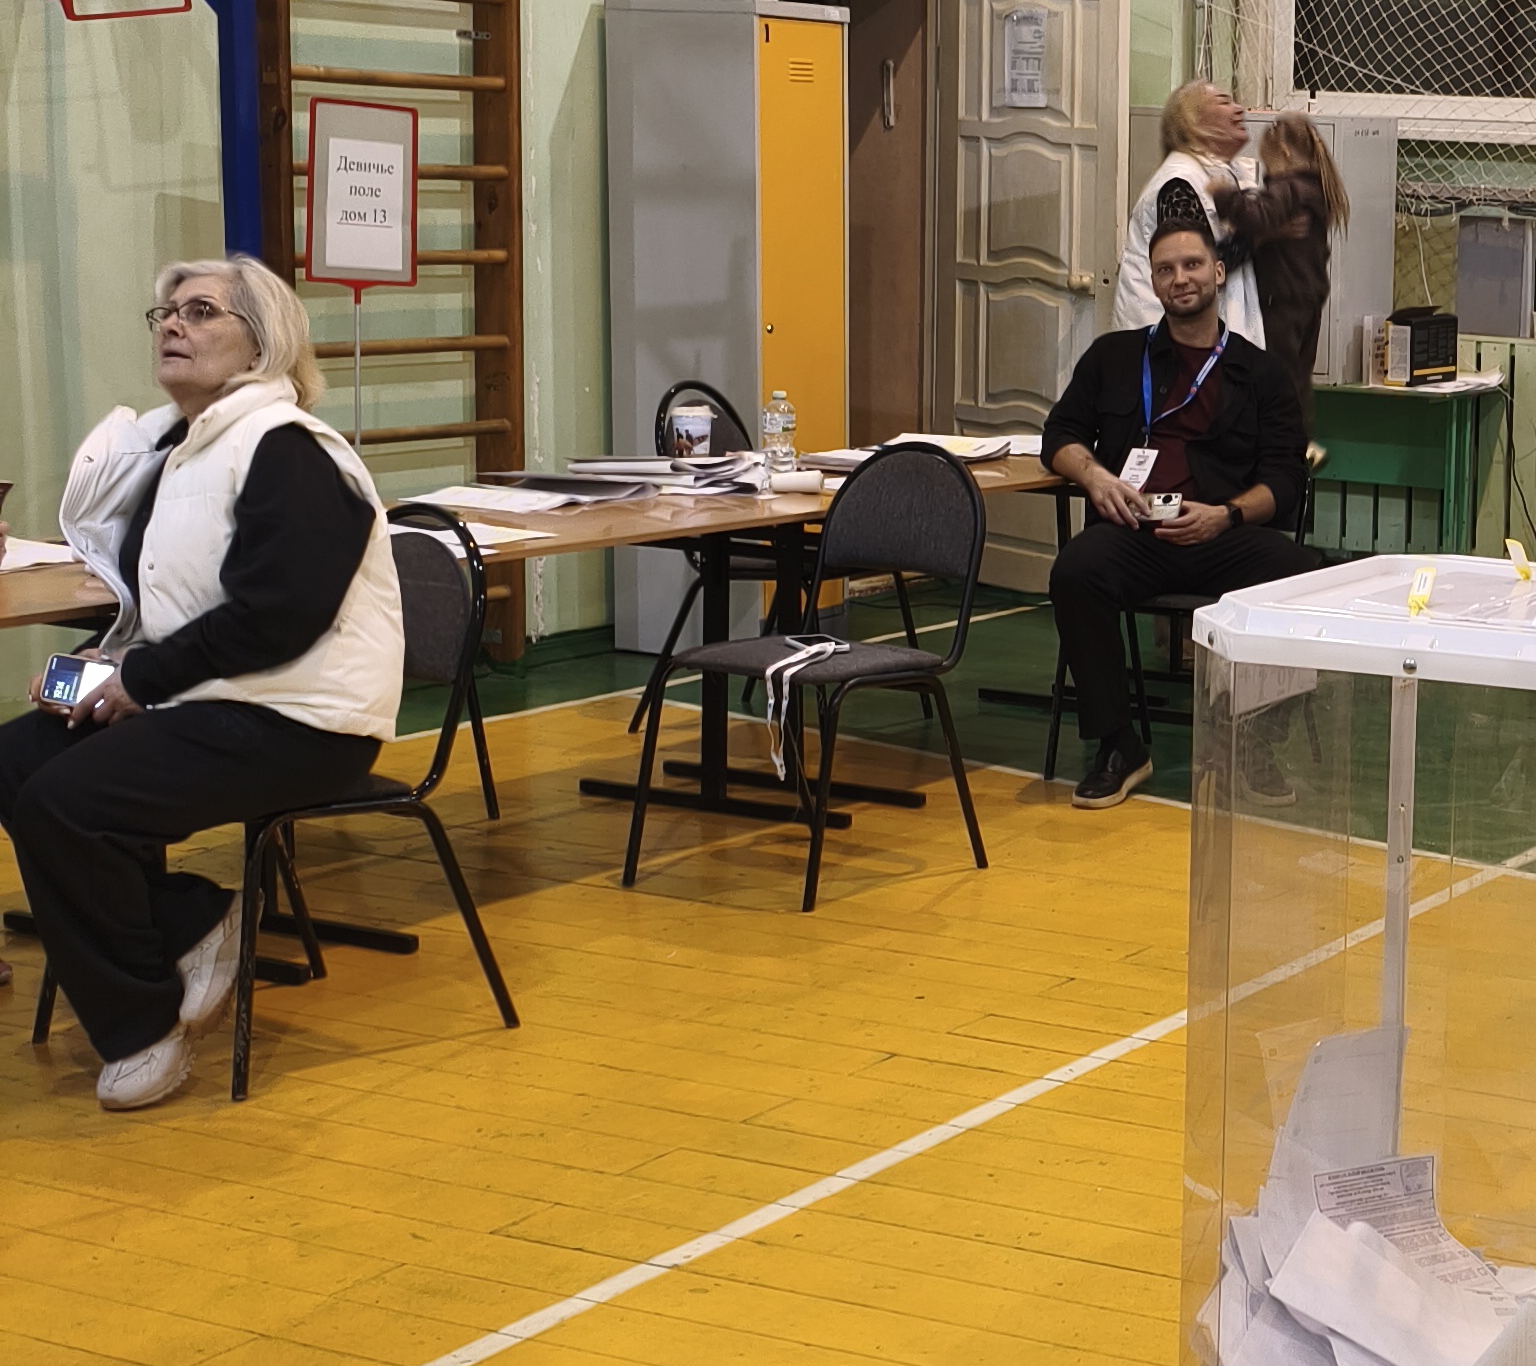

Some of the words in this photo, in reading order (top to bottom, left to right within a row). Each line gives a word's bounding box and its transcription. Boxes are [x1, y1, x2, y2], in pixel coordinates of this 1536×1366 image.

[336, 155, 394, 175] Девичье
[349, 185, 382, 198] поле
[340, 209, 367, 223] дом
[373, 208, 387, 224] 13
